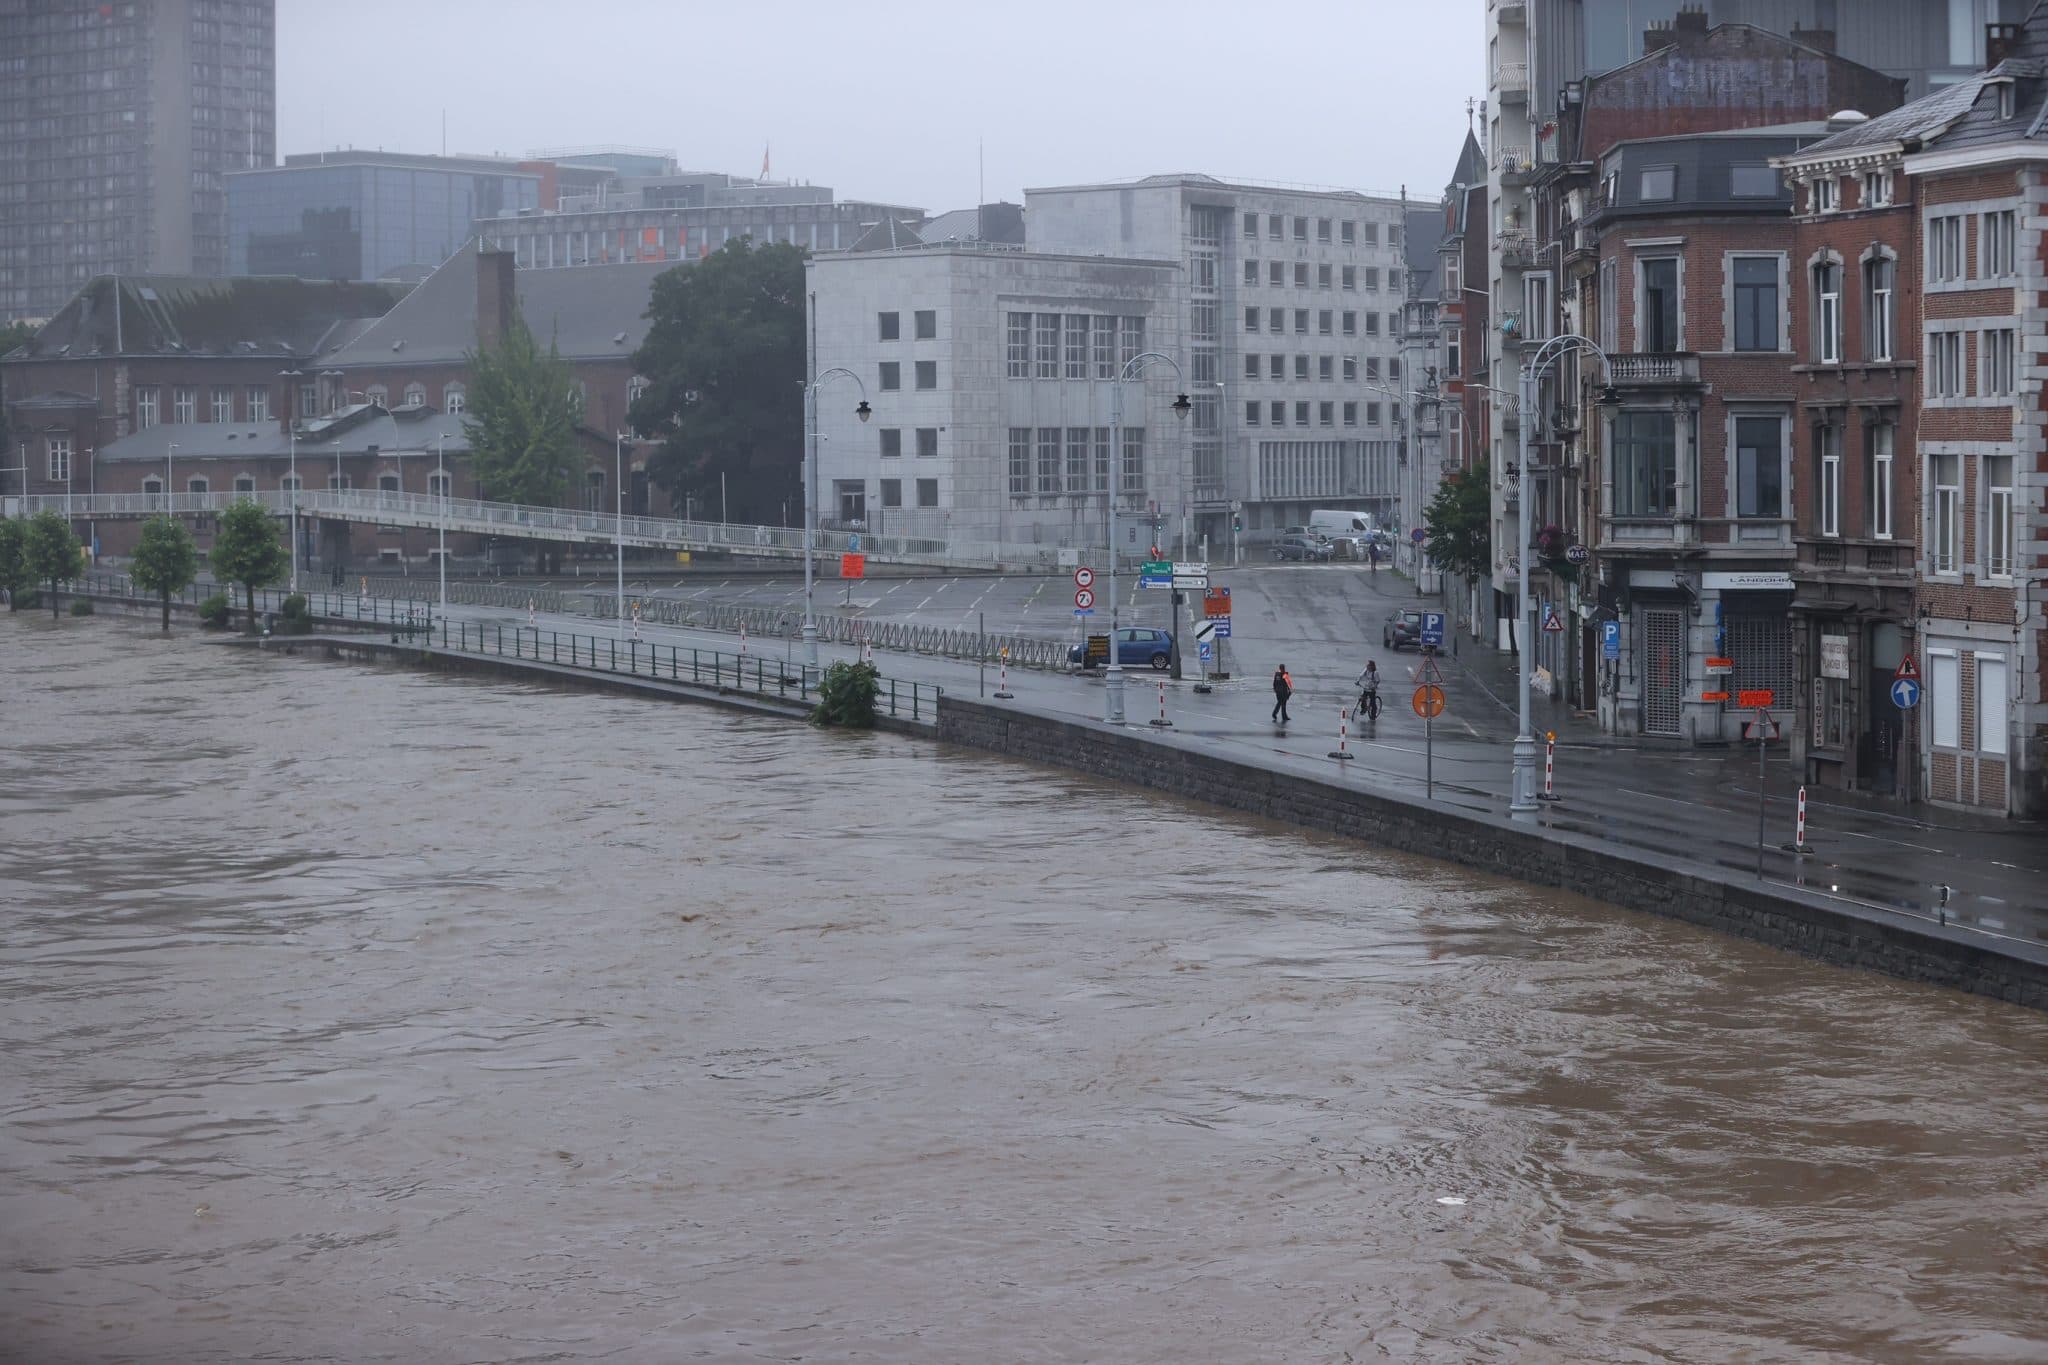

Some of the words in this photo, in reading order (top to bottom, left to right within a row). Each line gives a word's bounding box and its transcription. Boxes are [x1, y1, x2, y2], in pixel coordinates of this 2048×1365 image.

[1567, 550, 1590, 559] MAES
[1427, 614, 1439, 630] P
[1605, 625, 1616, 641] P
